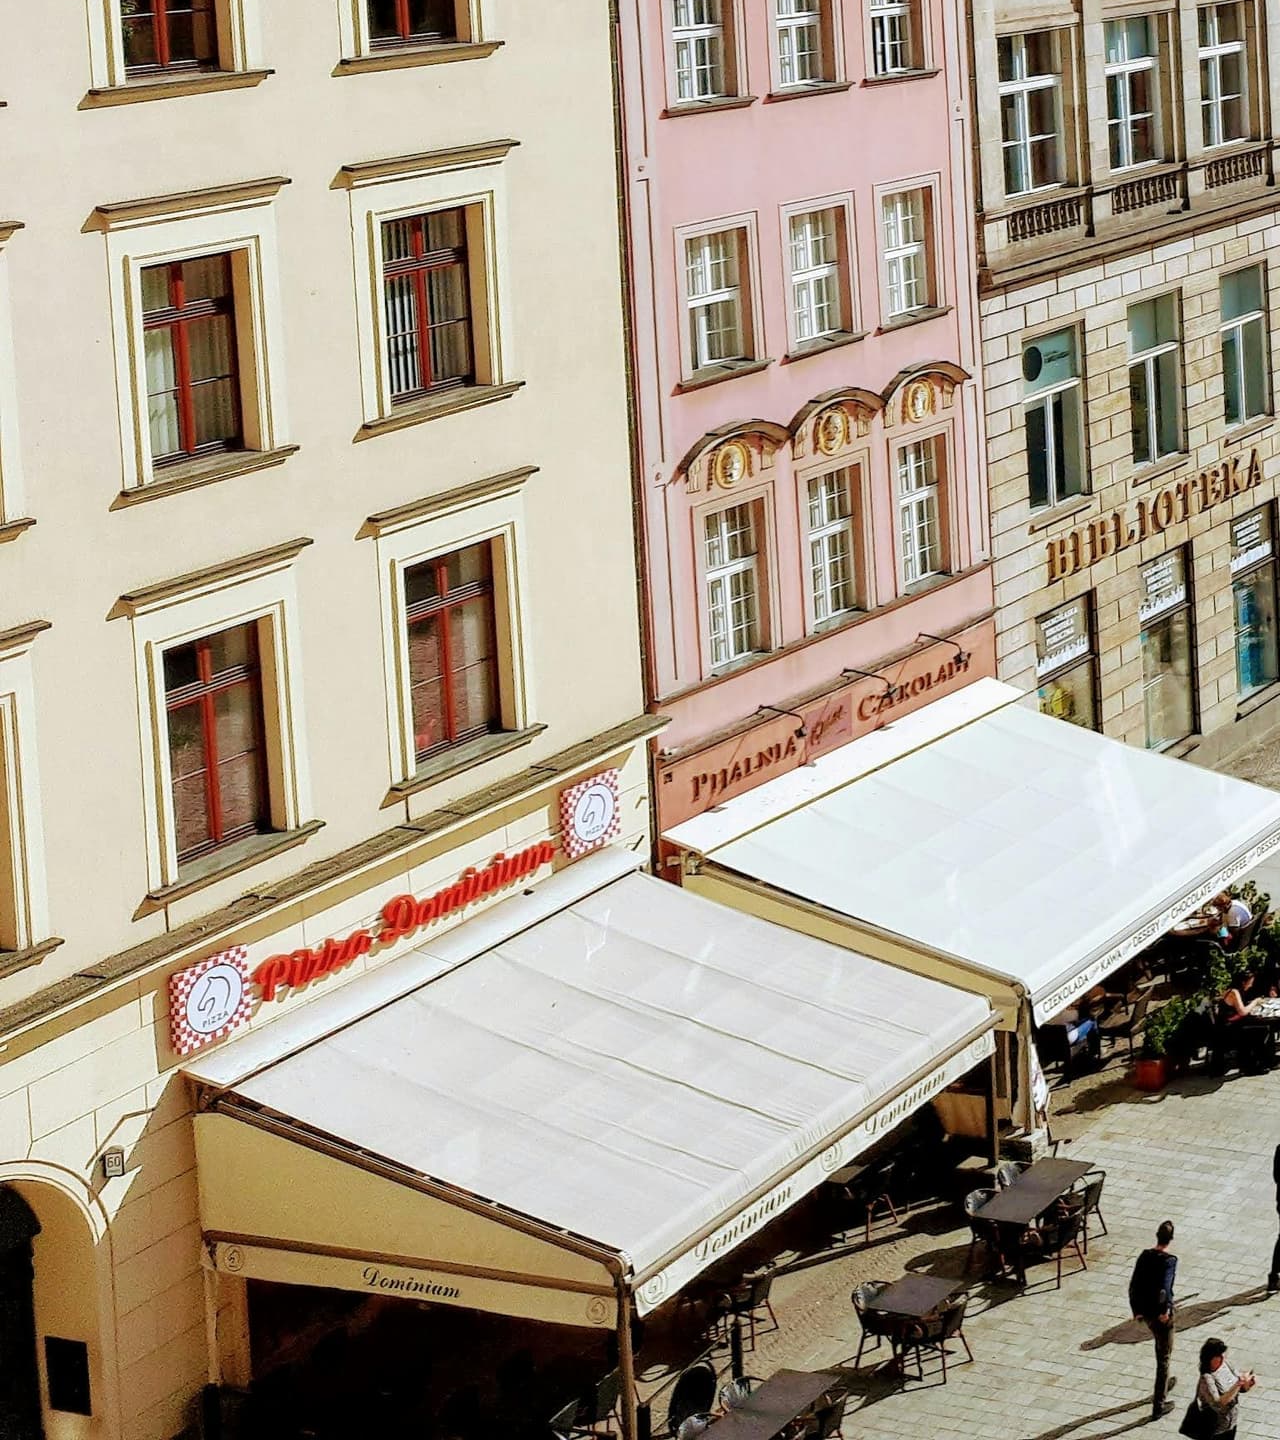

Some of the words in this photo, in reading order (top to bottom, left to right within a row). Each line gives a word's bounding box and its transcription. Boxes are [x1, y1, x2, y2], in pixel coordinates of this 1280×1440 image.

[1046, 448, 1264, 586] BIBLIOTEKA
[585, 824, 605, 838] PIZZA
[251, 929, 372, 1002] Pizza
[376, 840, 556, 942] Dominium
[1043, 974, 1089, 1013] CZEKOLADA
[1100, 949, 1122, 972] KAWA
[1132, 920, 1160, 947] DESERY
[1171, 881, 1213, 919] CHOCOLATE
[1221, 855, 1248, 882] COFFEE
[202, 1011, 229, 1028] PIZZA
[107, 1156, 120, 1168] 60
[693, 1185, 792, 1261] Dominium
[864, 1070, 946, 1135] Dominium
[362, 1265, 463, 1299] Dominium
